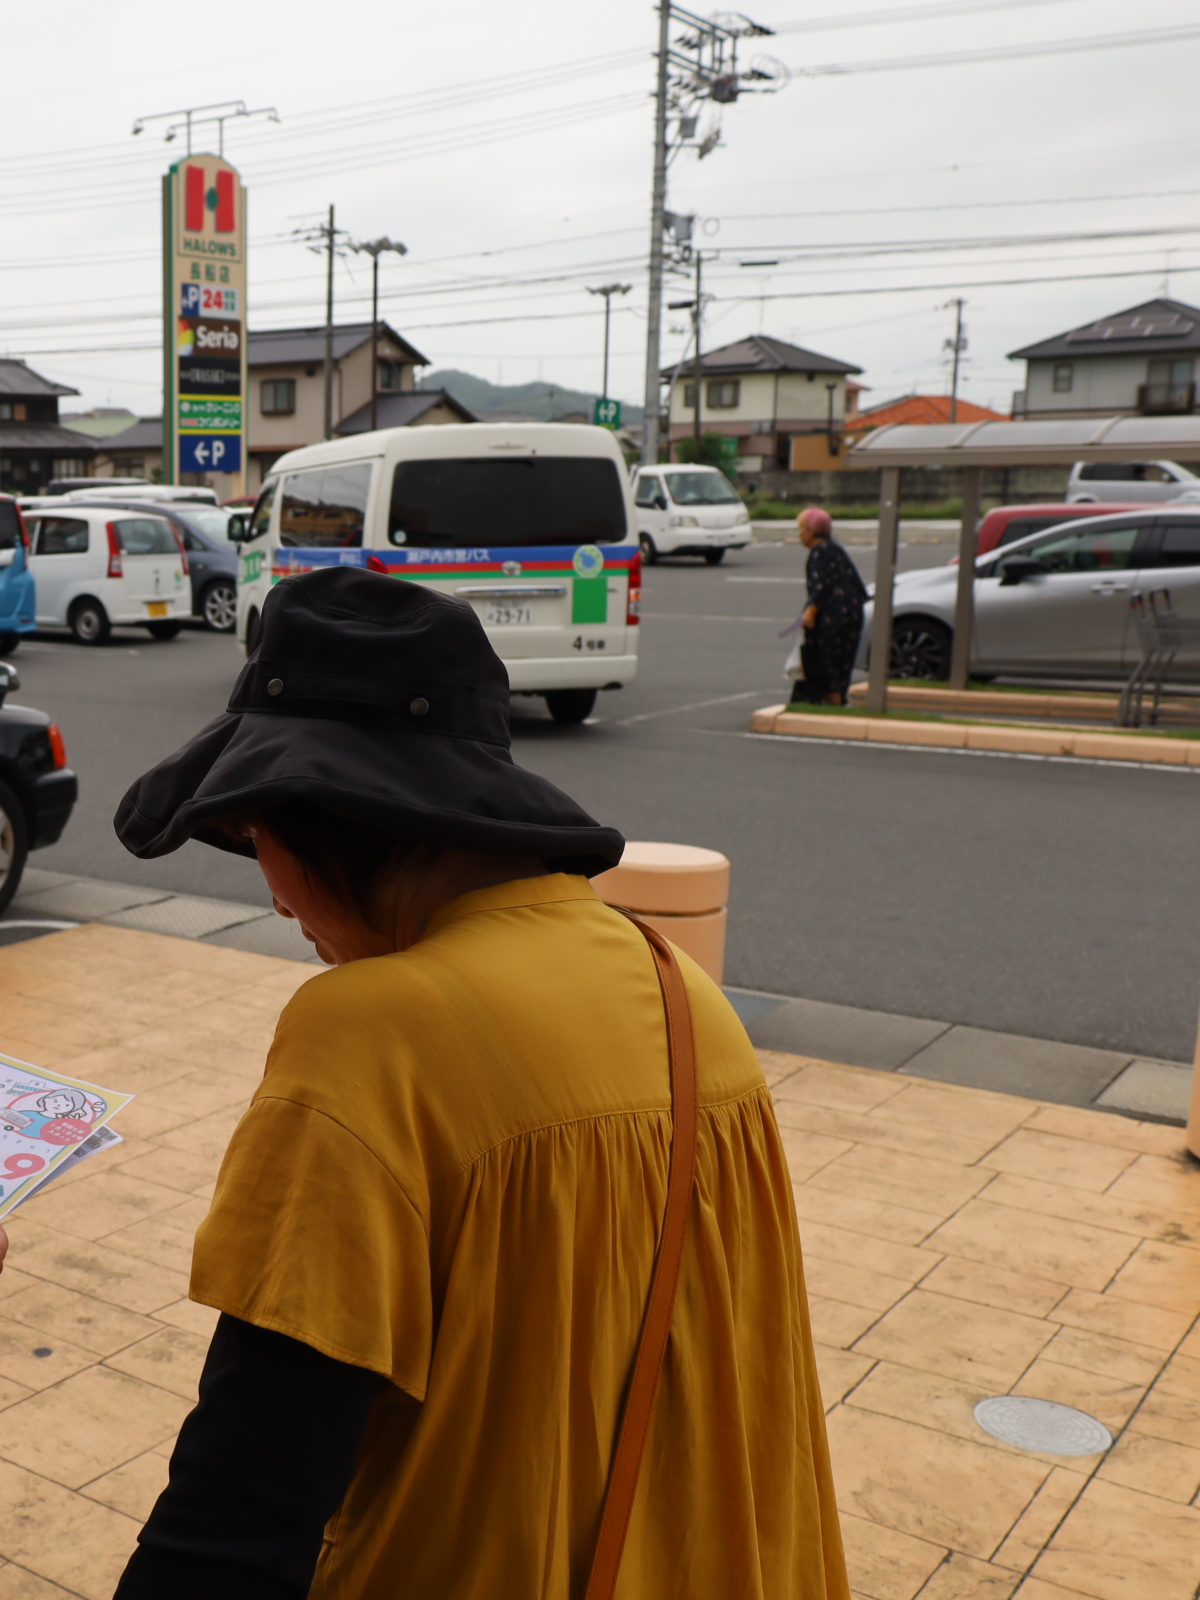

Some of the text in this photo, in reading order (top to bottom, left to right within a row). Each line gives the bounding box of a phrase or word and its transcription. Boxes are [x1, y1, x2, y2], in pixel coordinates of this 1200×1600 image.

[183, 237, 236, 257] HALOWS
[202, 288, 224, 310] 24
[196, 325, 239, 350] Seria
[211, 440, 226, 466] P
